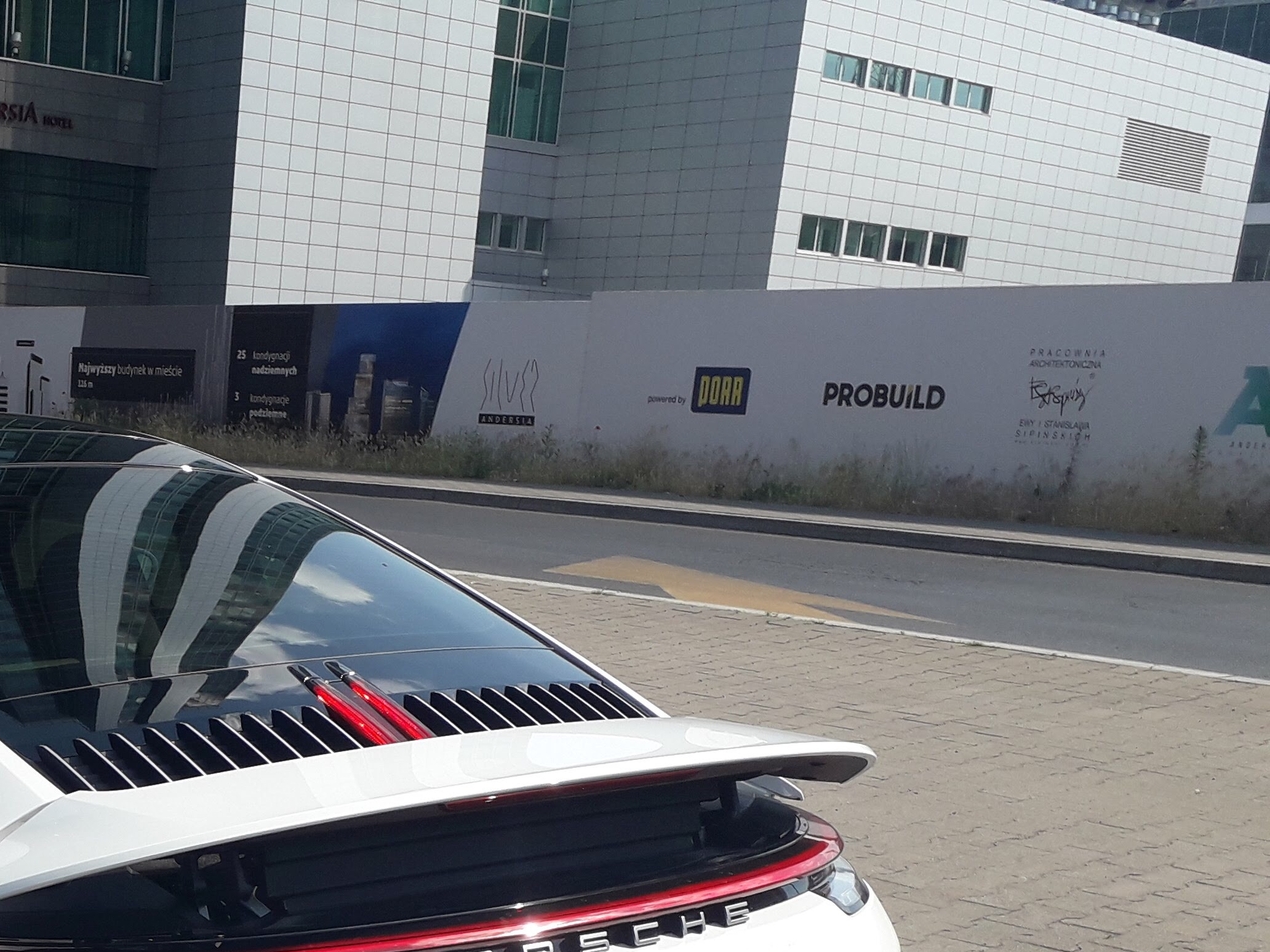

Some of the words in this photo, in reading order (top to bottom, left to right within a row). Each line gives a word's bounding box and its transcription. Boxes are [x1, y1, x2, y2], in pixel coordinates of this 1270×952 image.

[43, 116, 73, 129] HOTEL
[236, 349, 247, 360] 25
[252, 350, 291, 363] kondygnacji
[1030, 348, 1106, 357] PRACOWNIA
[78, 361, 117, 377] Najwyższy
[116, 363, 147, 377] budynek
[154, 364, 183, 377] mieście
[251, 364, 298, 378] nadziemnych
[234, 391, 240, 402] 3
[250, 393, 290, 407] kondygnacje
[647, 394, 677, 404] powered
[677, 395, 687, 406] by
[822, 382, 946, 410] PROBUILD
[249, 407, 287, 419] podziemne
[480, 415, 533, 425] ANDERSIA
